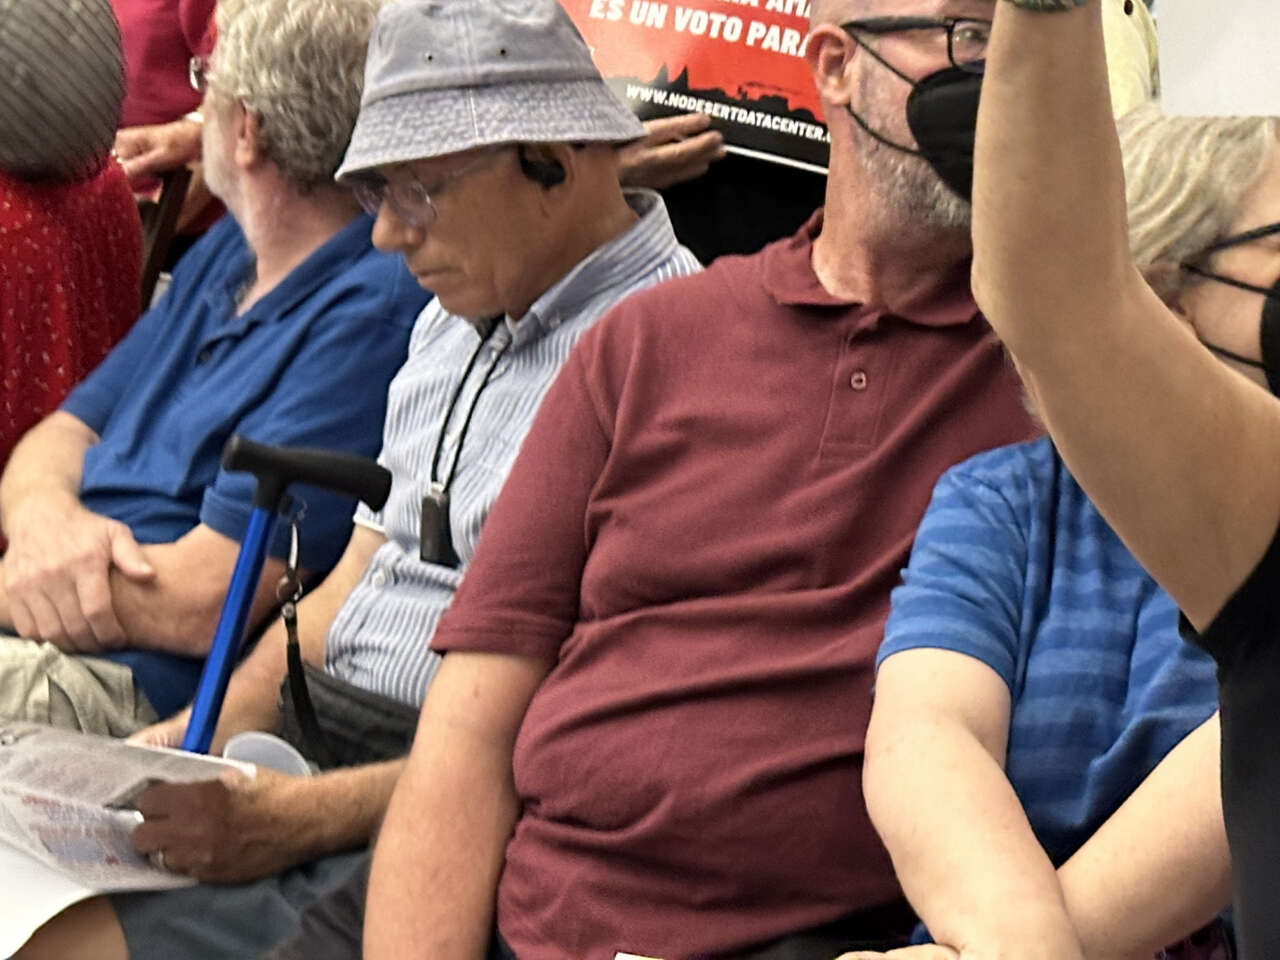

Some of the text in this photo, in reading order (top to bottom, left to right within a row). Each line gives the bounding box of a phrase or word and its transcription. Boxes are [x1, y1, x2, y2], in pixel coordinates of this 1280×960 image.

[629, 1, 667, 29] UN
[673, 6, 743, 42] VOTO
[626, 84, 831, 143] WWW.NODESERTDATACENTER.
